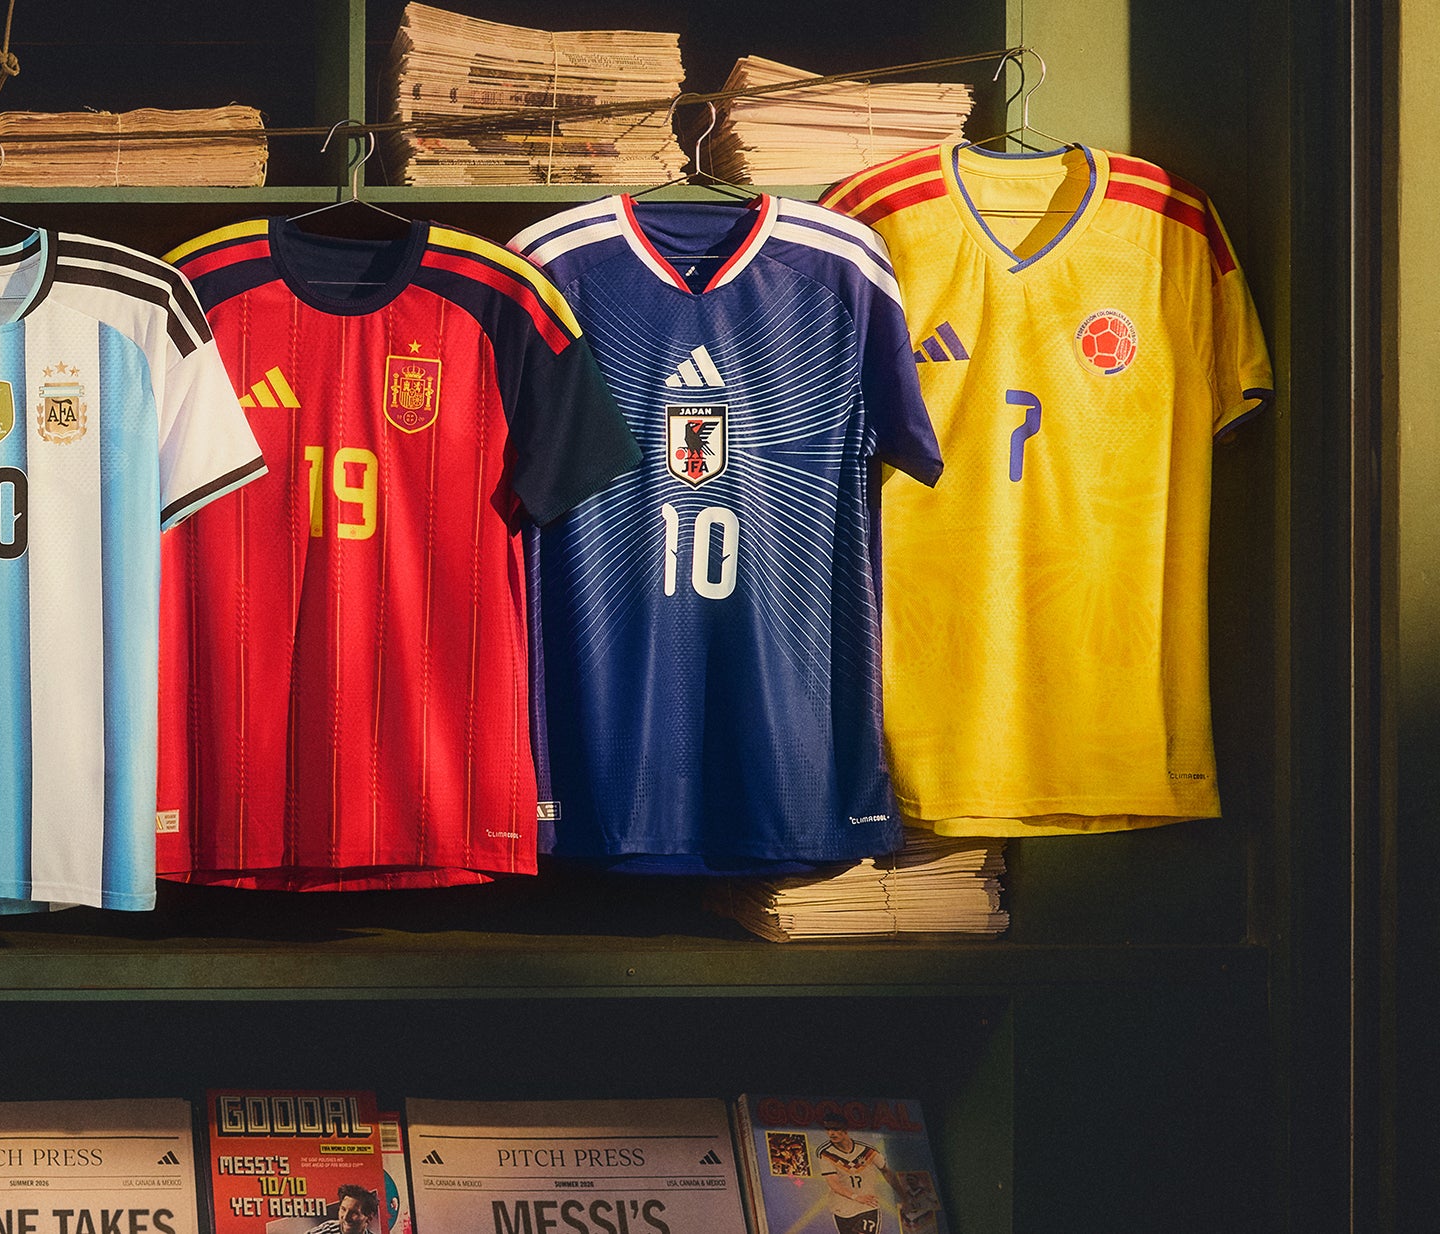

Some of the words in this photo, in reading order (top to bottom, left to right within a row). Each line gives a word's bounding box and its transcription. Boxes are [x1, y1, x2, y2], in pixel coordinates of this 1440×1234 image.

[47, 398, 77, 427] AFA
[1005, 389, 1043, 483] 7
[681, 461, 709, 473] JFA
[304, 445, 379, 541] 19
[662, 502, 740, 600] 10
[33, 1149, 103, 1167] PRESS
[217, 1155, 290, 1175] MESSI'S
[497, 1149, 565, 1167] PITCH
[575, 1148, 646, 1167] PRESS
[258, 1176, 308, 1196] 10/10
[462, 1180, 482, 1188] MEXICO
[680, 1179, 700, 1187] CANADA
[706, 1179, 727, 1187] MEXICO
[849, 1175, 862, 1188] 17
[230, 1197, 264, 1217] YET
[268, 1198, 328, 1218] AGAIN
[491, 1199, 671, 1234] MESSI'S
[862, 1219, 876, 1232] 17
